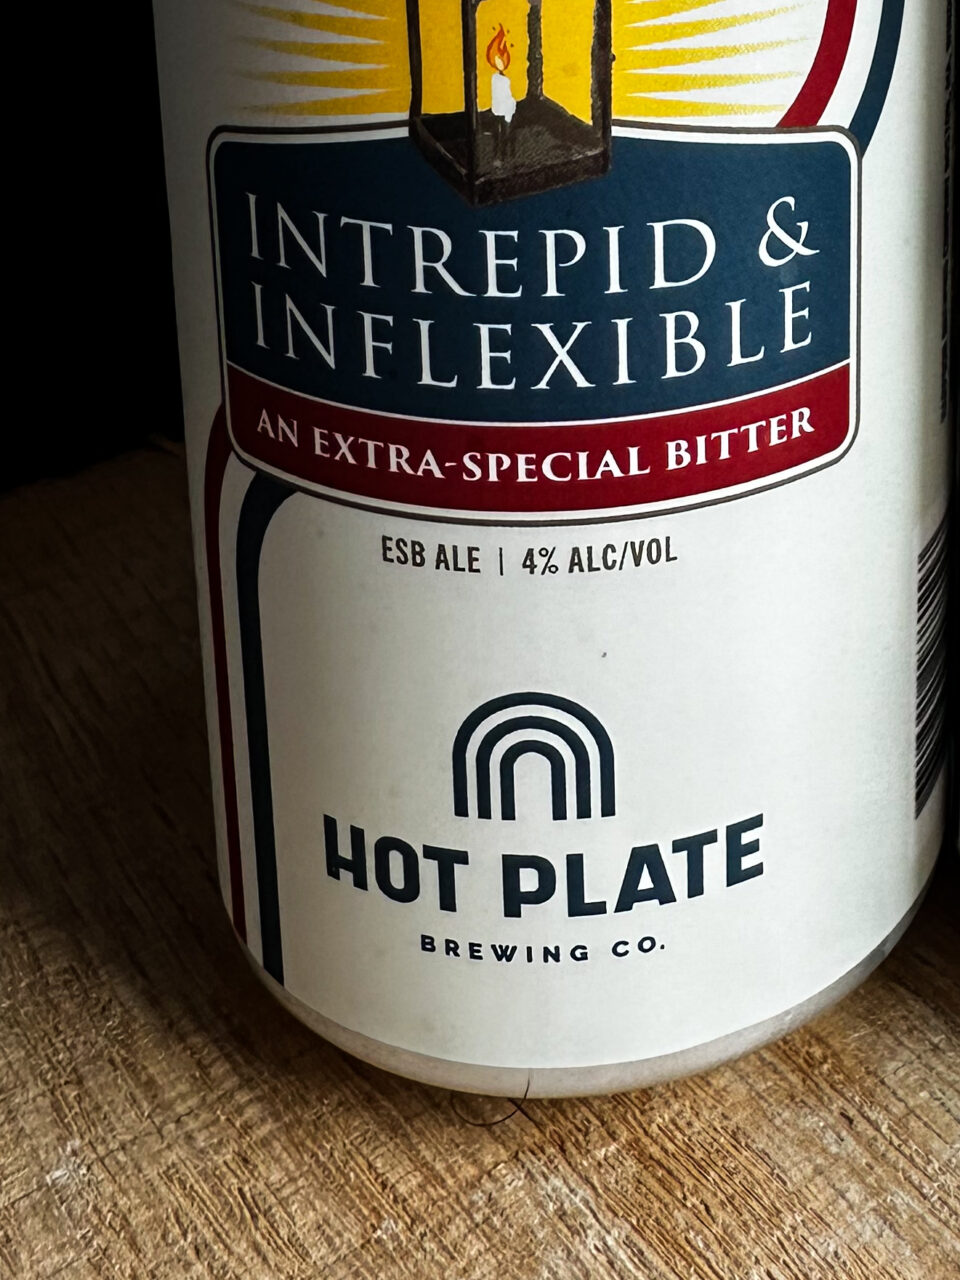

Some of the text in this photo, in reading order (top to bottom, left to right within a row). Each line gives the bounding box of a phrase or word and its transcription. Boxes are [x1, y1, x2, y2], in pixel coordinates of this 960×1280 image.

[245, 192, 821, 298] INTREPID &
[250, 281, 814, 391] INFLEXIBLE
[256, 407, 815, 483] AN EXTRA-SPECIAL BITTER
[381, 536, 426, 568] ESB
[434, 545, 481, 573] ALE
[521, 546, 560, 576] 4%
[568, 536, 678, 573] ALC/VOL
[323, 813, 764, 918] HOT PLATE
[420, 934, 665, 963] BREWING CO.
